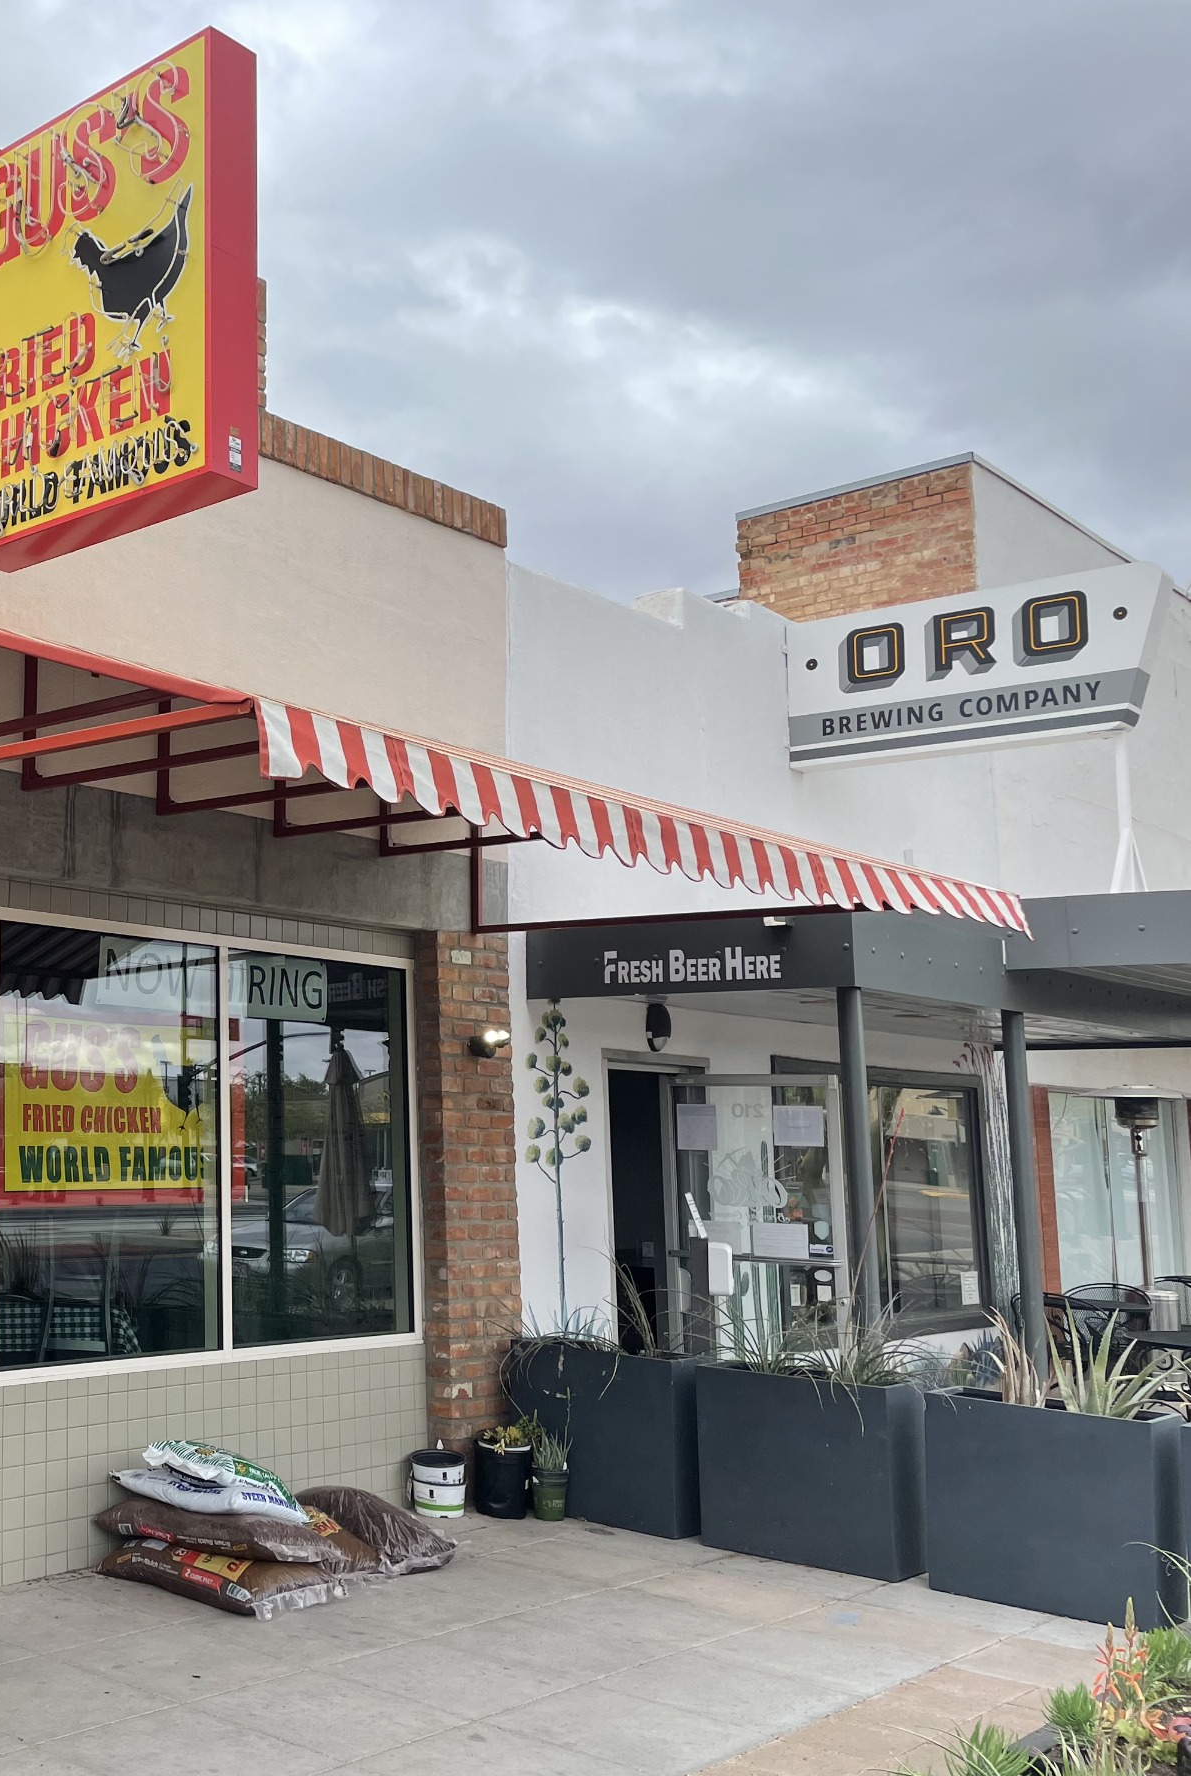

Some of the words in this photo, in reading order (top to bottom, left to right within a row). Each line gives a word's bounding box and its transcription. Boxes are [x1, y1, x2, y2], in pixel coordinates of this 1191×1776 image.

[62, 418, 197, 505] FAMOUS
[838, 590, 1090, 694] ORO
[821, 701, 943, 737] BREWING
[959, 680, 1102, 719] COMPANY
[105, 948, 200, 999] NOW
[604, 950, 664, 984] FRESH
[669, 949, 721, 982] BEER
[724, 946, 782, 980] HERE
[20, 1019, 142, 1094] GUS'S
[22, 1103, 75, 1133] FRIED
[80, 1105, 162, 1134] CHICKEN
[18, 1145, 111, 1183] WORLD
[241, 1492, 267, 1503] STEER
[184, 1568, 191, 1577] 2
